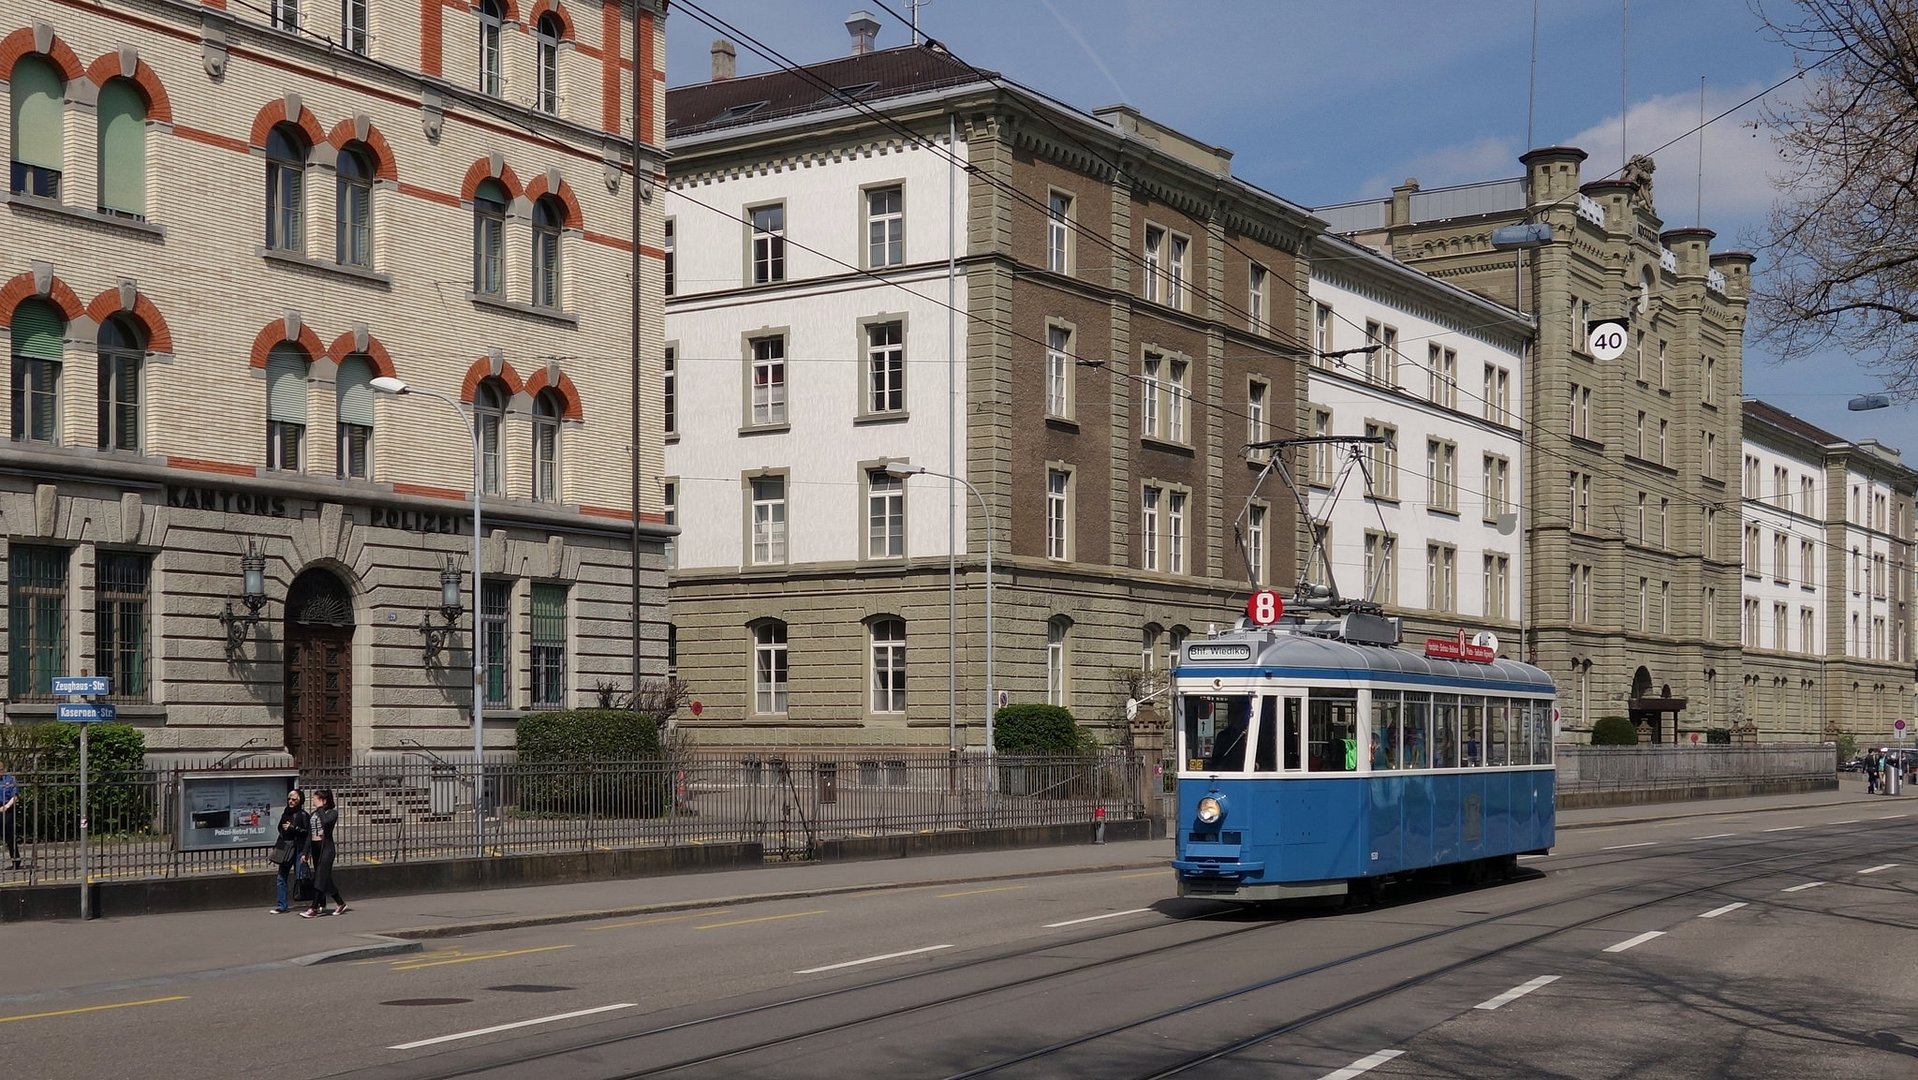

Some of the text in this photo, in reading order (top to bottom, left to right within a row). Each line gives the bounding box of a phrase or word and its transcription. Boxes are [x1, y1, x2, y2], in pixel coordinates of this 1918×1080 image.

[1594, 332, 1622, 349] 40
[167, 487, 460, 534] KANTONS POLIZEI
[1256, 592, 1275, 624] 8
[1460, 630, 1465, 657] 8
[55, 681, 105, 693] Zeughaus-Str.
[1190, 760, 1203, 769] 92
